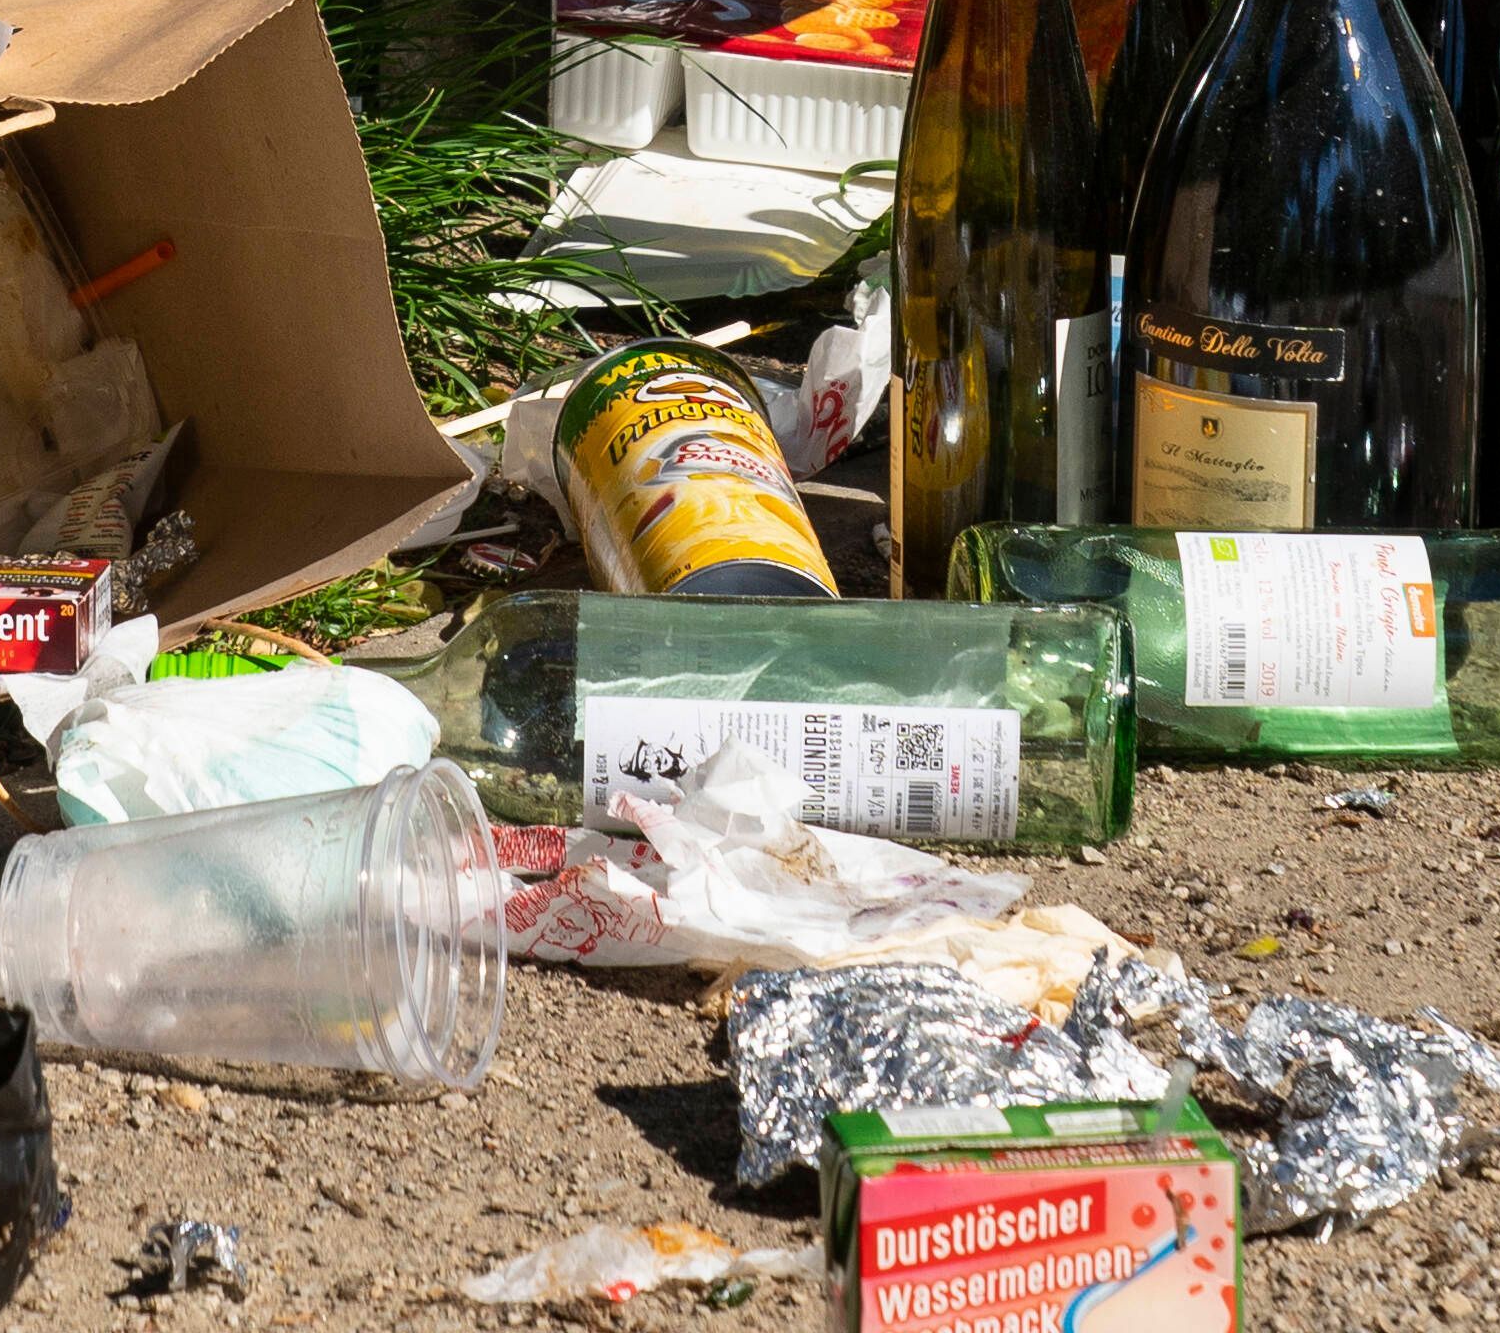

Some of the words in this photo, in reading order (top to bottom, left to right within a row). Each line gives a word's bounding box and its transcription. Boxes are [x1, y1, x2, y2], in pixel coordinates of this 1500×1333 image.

[1135, 313, 1194, 349] Cantina
[1200, 325, 1262, 359] Della
[1266, 337, 1328, 365] Volta
[60, 604, 75, 617] 20
[1260, 662, 1277, 697] 2019
[949, 763, 962, 795] REWE
[875, 1192, 1094, 1272] Durstlöscher
[877, 1243, 1149, 1326] Wassermelonen-
